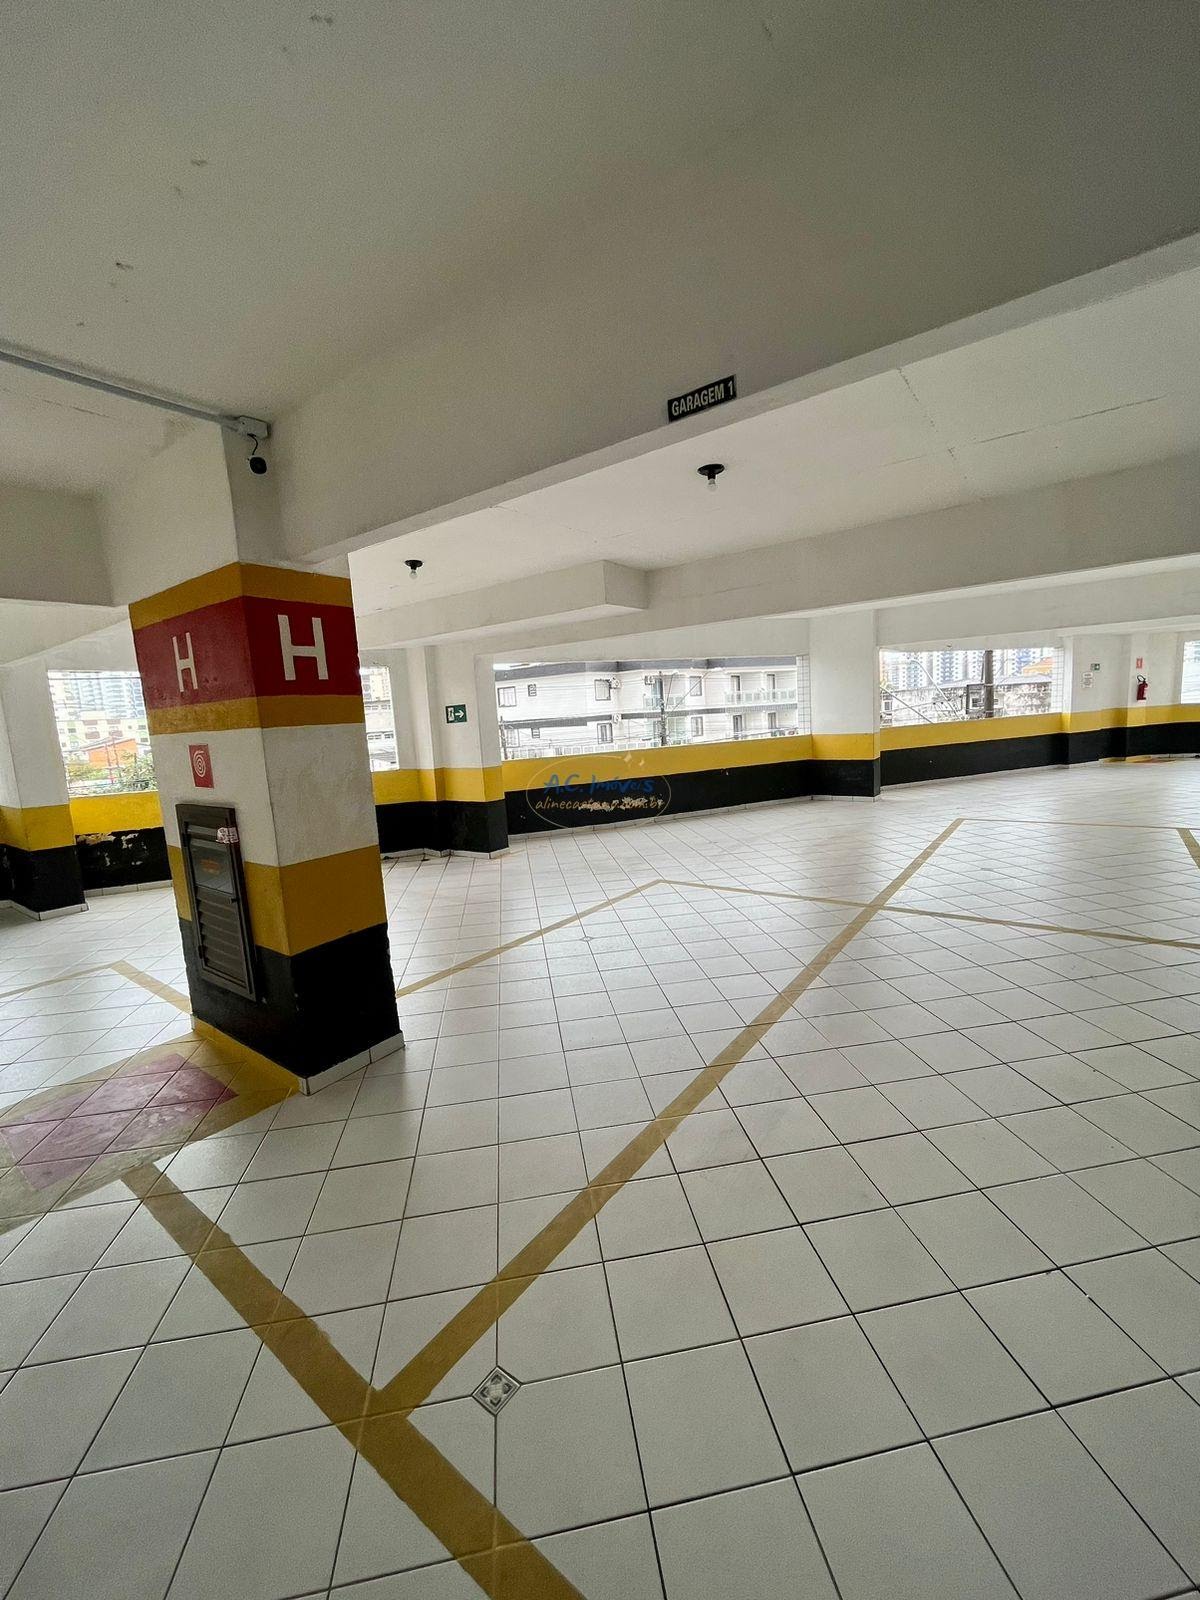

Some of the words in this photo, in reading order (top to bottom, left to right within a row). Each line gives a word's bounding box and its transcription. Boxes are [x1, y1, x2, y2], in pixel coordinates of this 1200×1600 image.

[671, 383, 724, 416] GARAGEM
[728, 380, 733, 396] 1
[172, 632, 199, 692] H
[278, 614, 329, 681] H
